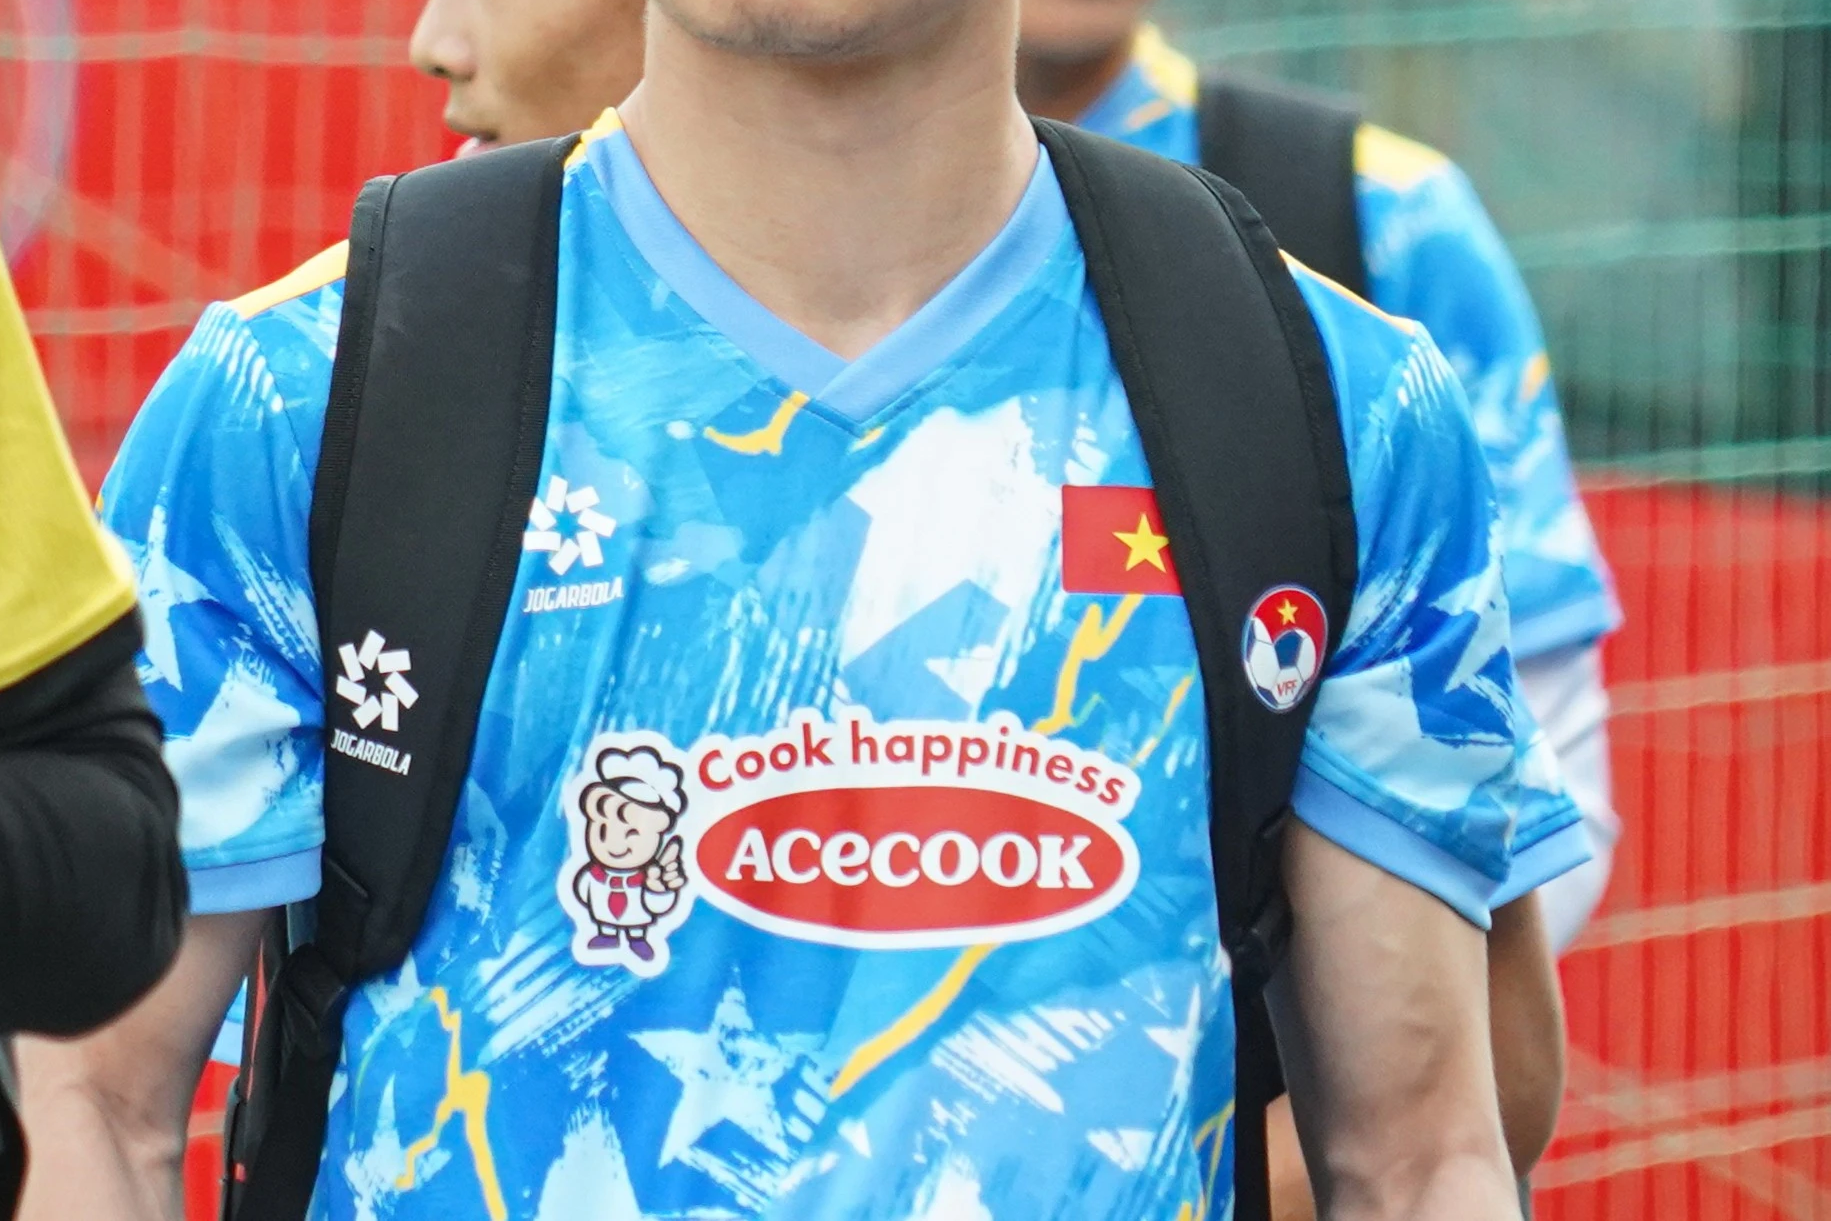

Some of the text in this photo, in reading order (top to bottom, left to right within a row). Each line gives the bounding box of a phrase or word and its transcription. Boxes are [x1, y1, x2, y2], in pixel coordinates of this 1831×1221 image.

[523, 575, 624, 613] JOGARBOLA
[1276, 678, 1298, 697] VFF
[330, 728, 412, 776] JOGARBOLA
[698, 720, 1127, 808] Cook happiness
